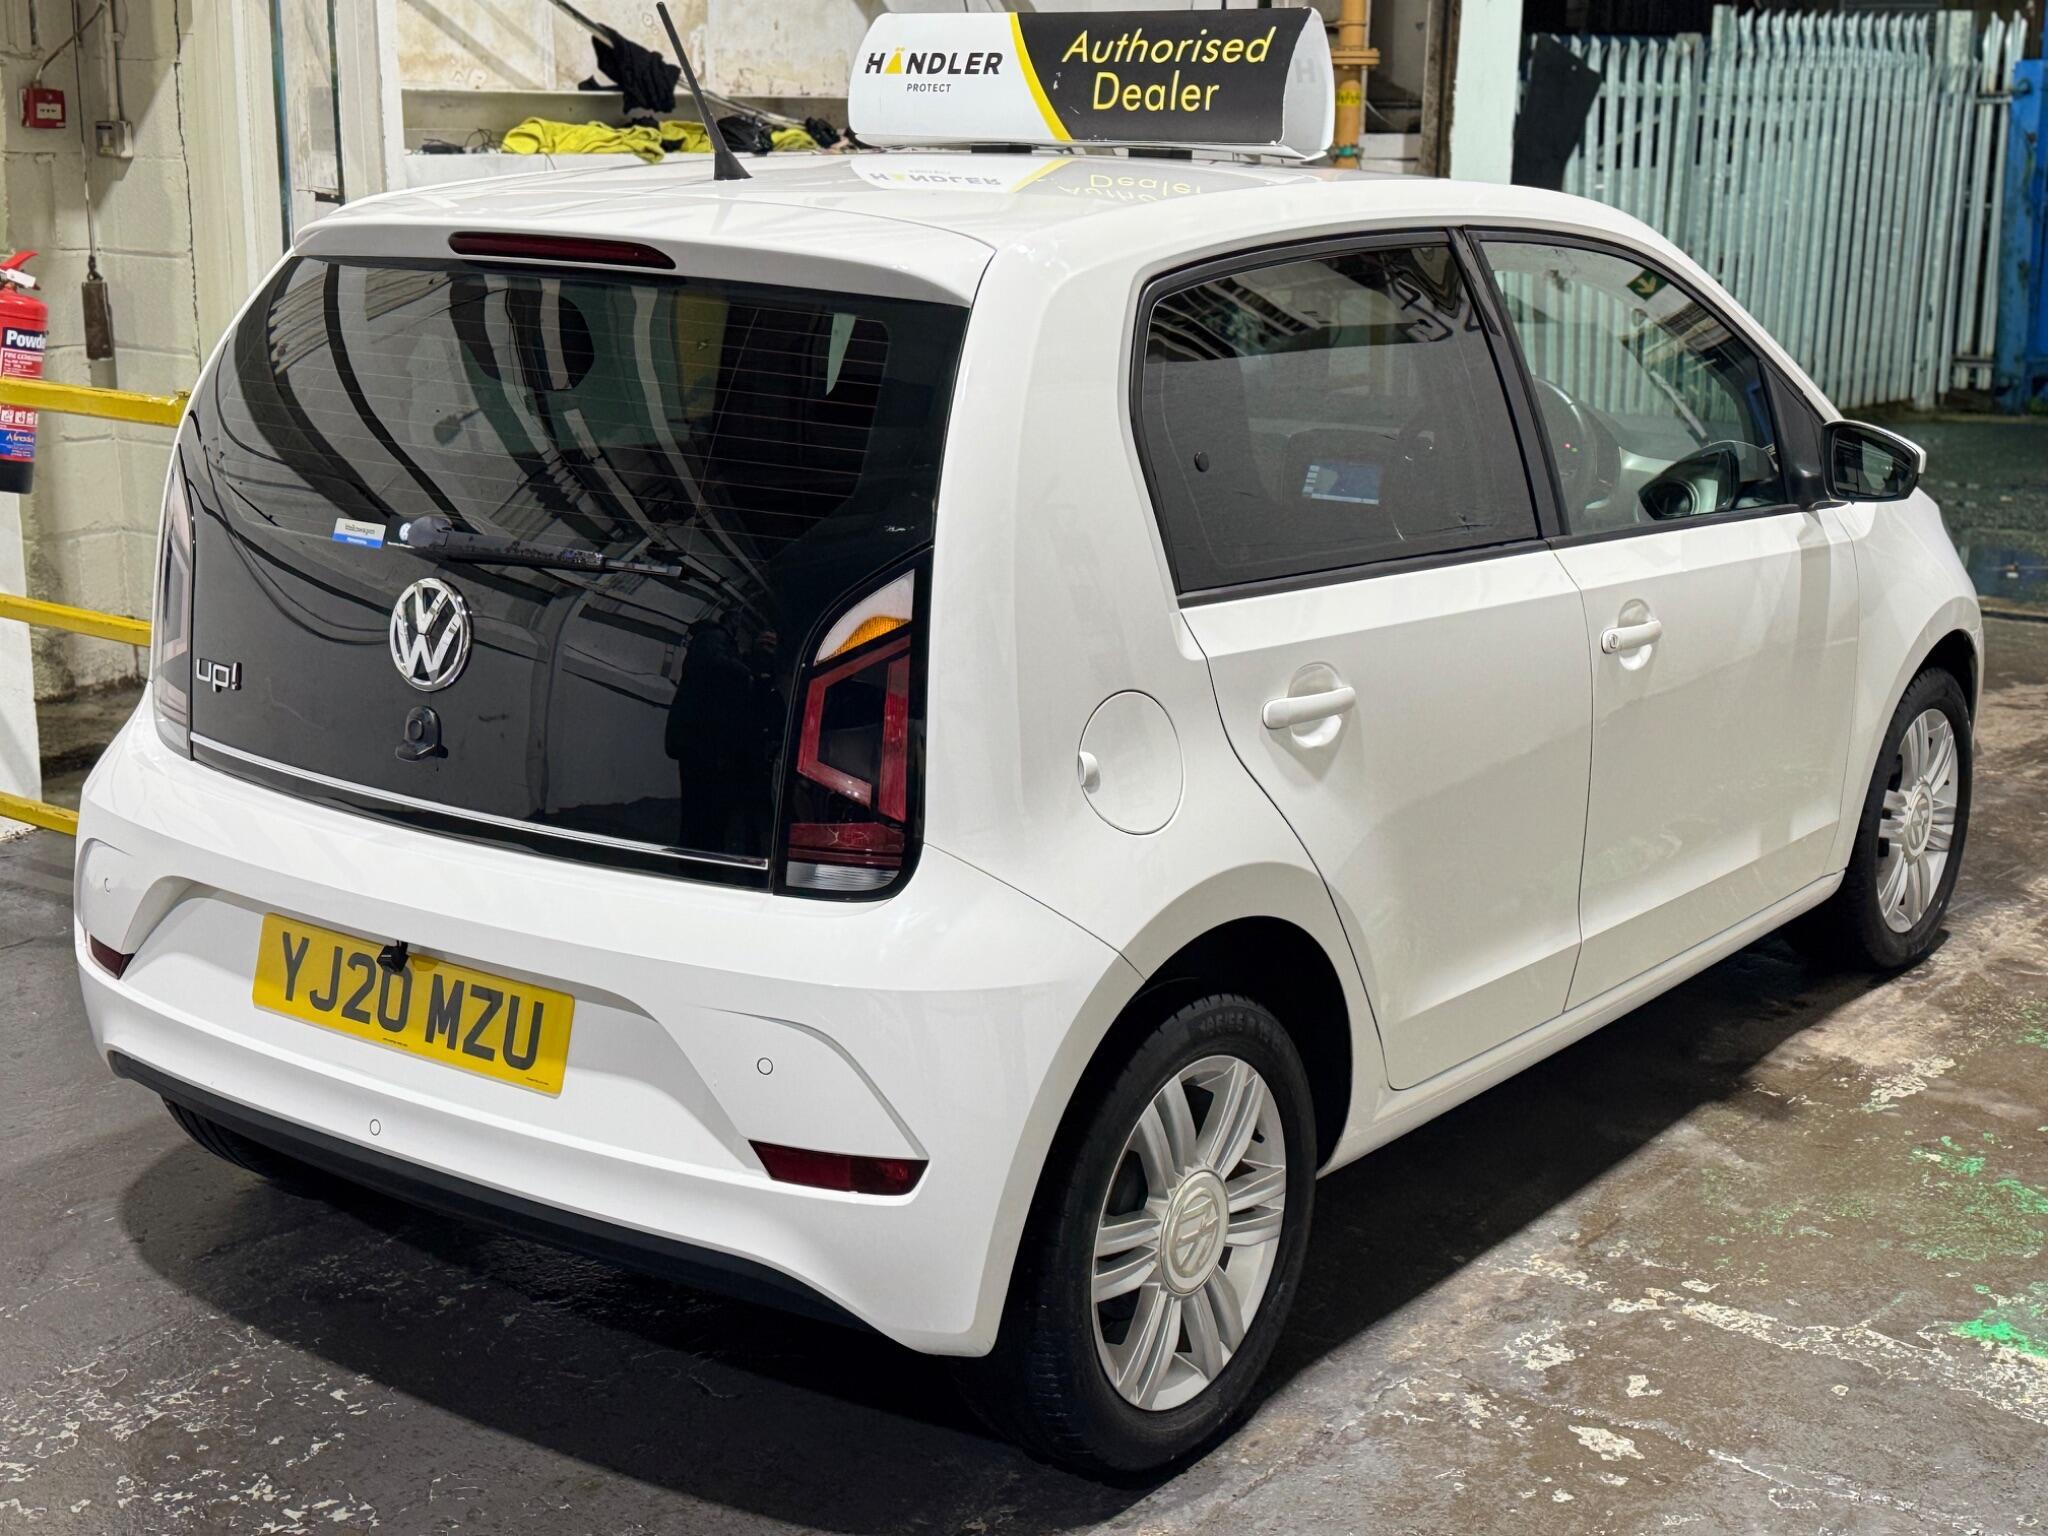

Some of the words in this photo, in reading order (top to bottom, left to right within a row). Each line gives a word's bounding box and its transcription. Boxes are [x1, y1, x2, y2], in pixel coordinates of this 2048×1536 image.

[865, 47, 1003, 75] HÄNDLER
[1062, 26, 1278, 64] Authorised
[906, 83, 952, 93] PROTECT
[1092, 70, 1220, 111] Dealer
[196, 656, 243, 693] up!
[282, 931, 414, 1033] YJ20
[424, 973, 545, 1071] MZU
